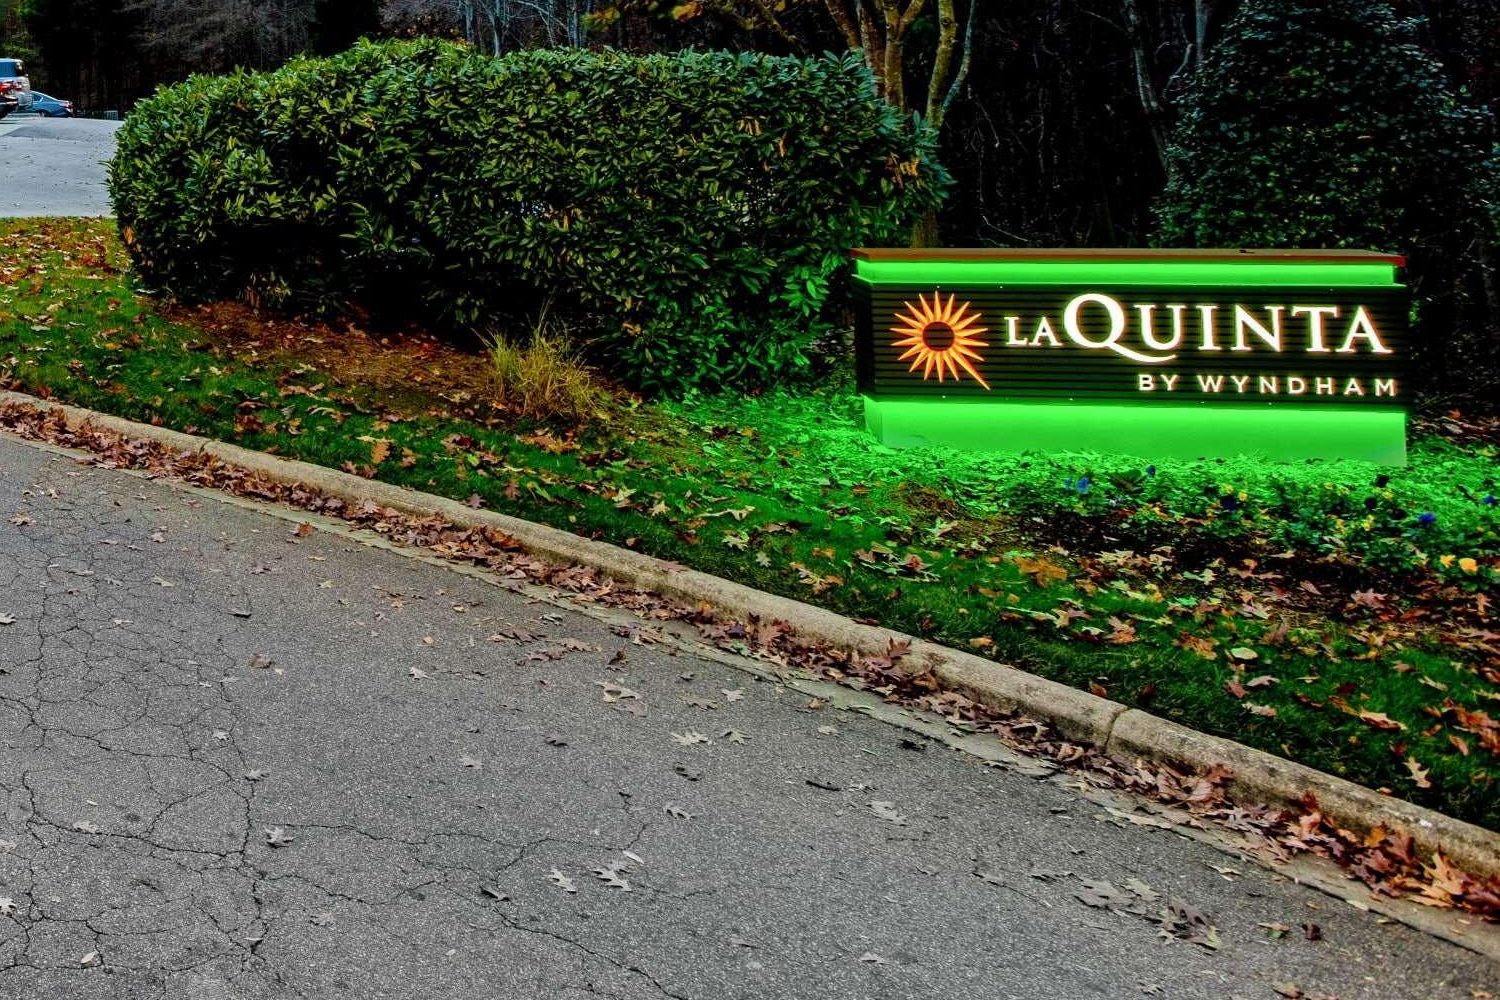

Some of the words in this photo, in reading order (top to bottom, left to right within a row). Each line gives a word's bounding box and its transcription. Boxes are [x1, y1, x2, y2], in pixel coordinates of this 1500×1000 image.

[1063, 292, 1394, 363] QUINTA
[1138, 373, 1180, 392] BY
[1196, 374, 1397, 397] WYNDHAM
